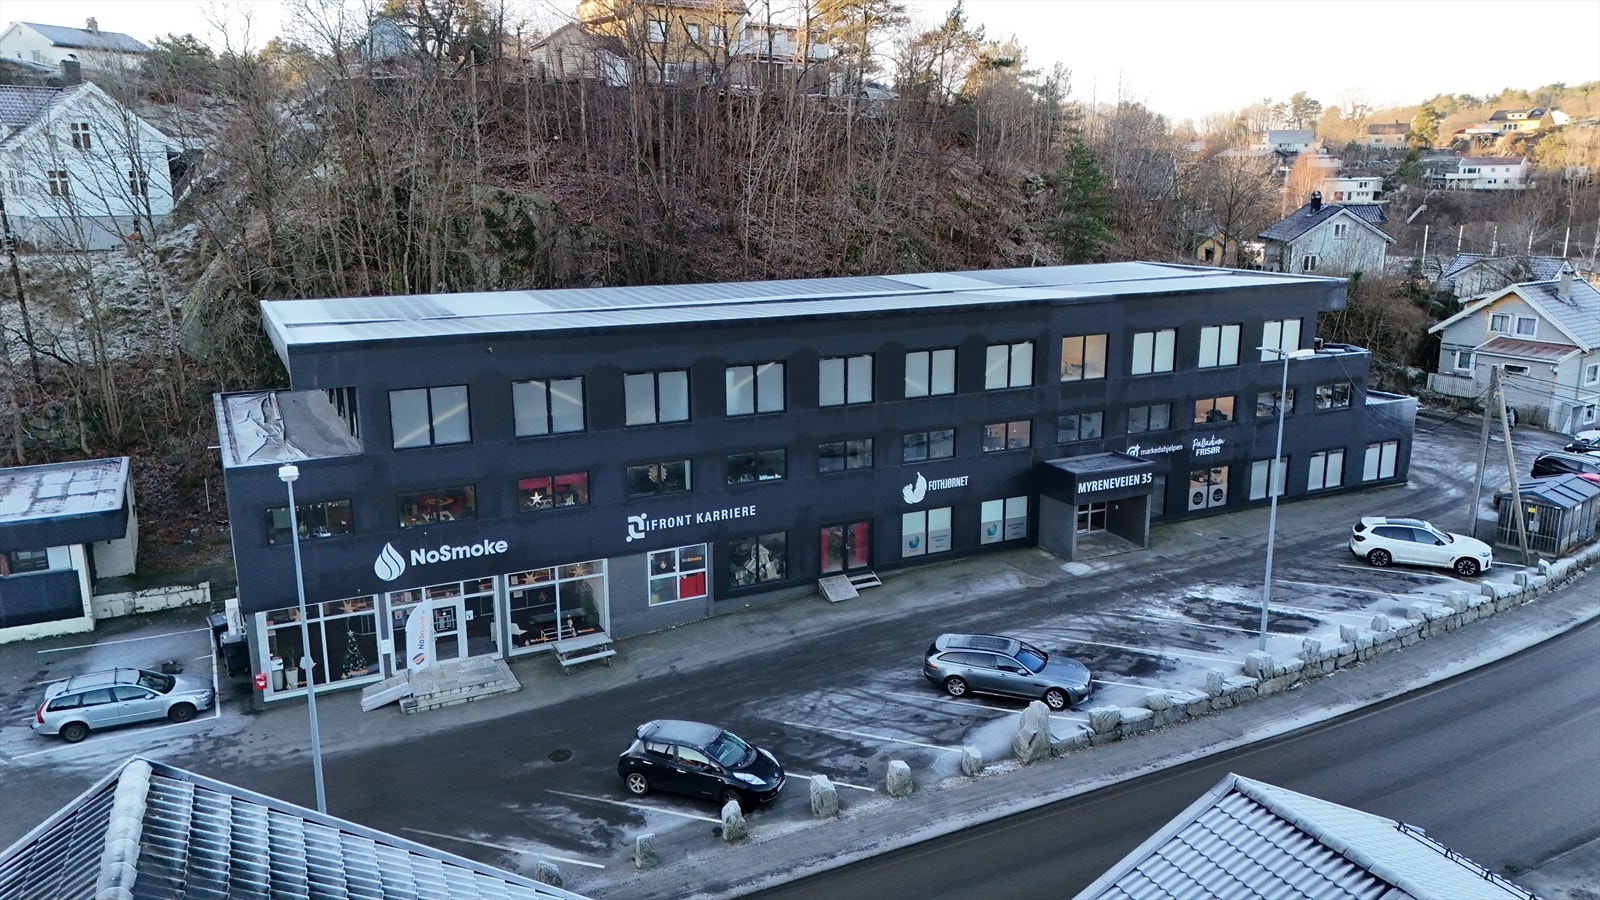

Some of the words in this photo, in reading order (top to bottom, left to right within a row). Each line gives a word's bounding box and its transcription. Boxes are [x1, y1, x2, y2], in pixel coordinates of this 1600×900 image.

[1140, 444, 1183, 456] markedshjelpen
[1192, 435, 1226, 451] Palladium
[1195, 446, 1221, 457] FRISØR
[928, 475, 969, 491] FOTHJØRNET
[1077, 474, 1140, 494] MYRENEVEIEN
[1141, 473, 1153, 484] 35
[696, 505, 756, 524] KARRIERE
[410, 539, 509, 567] NoSmoke
